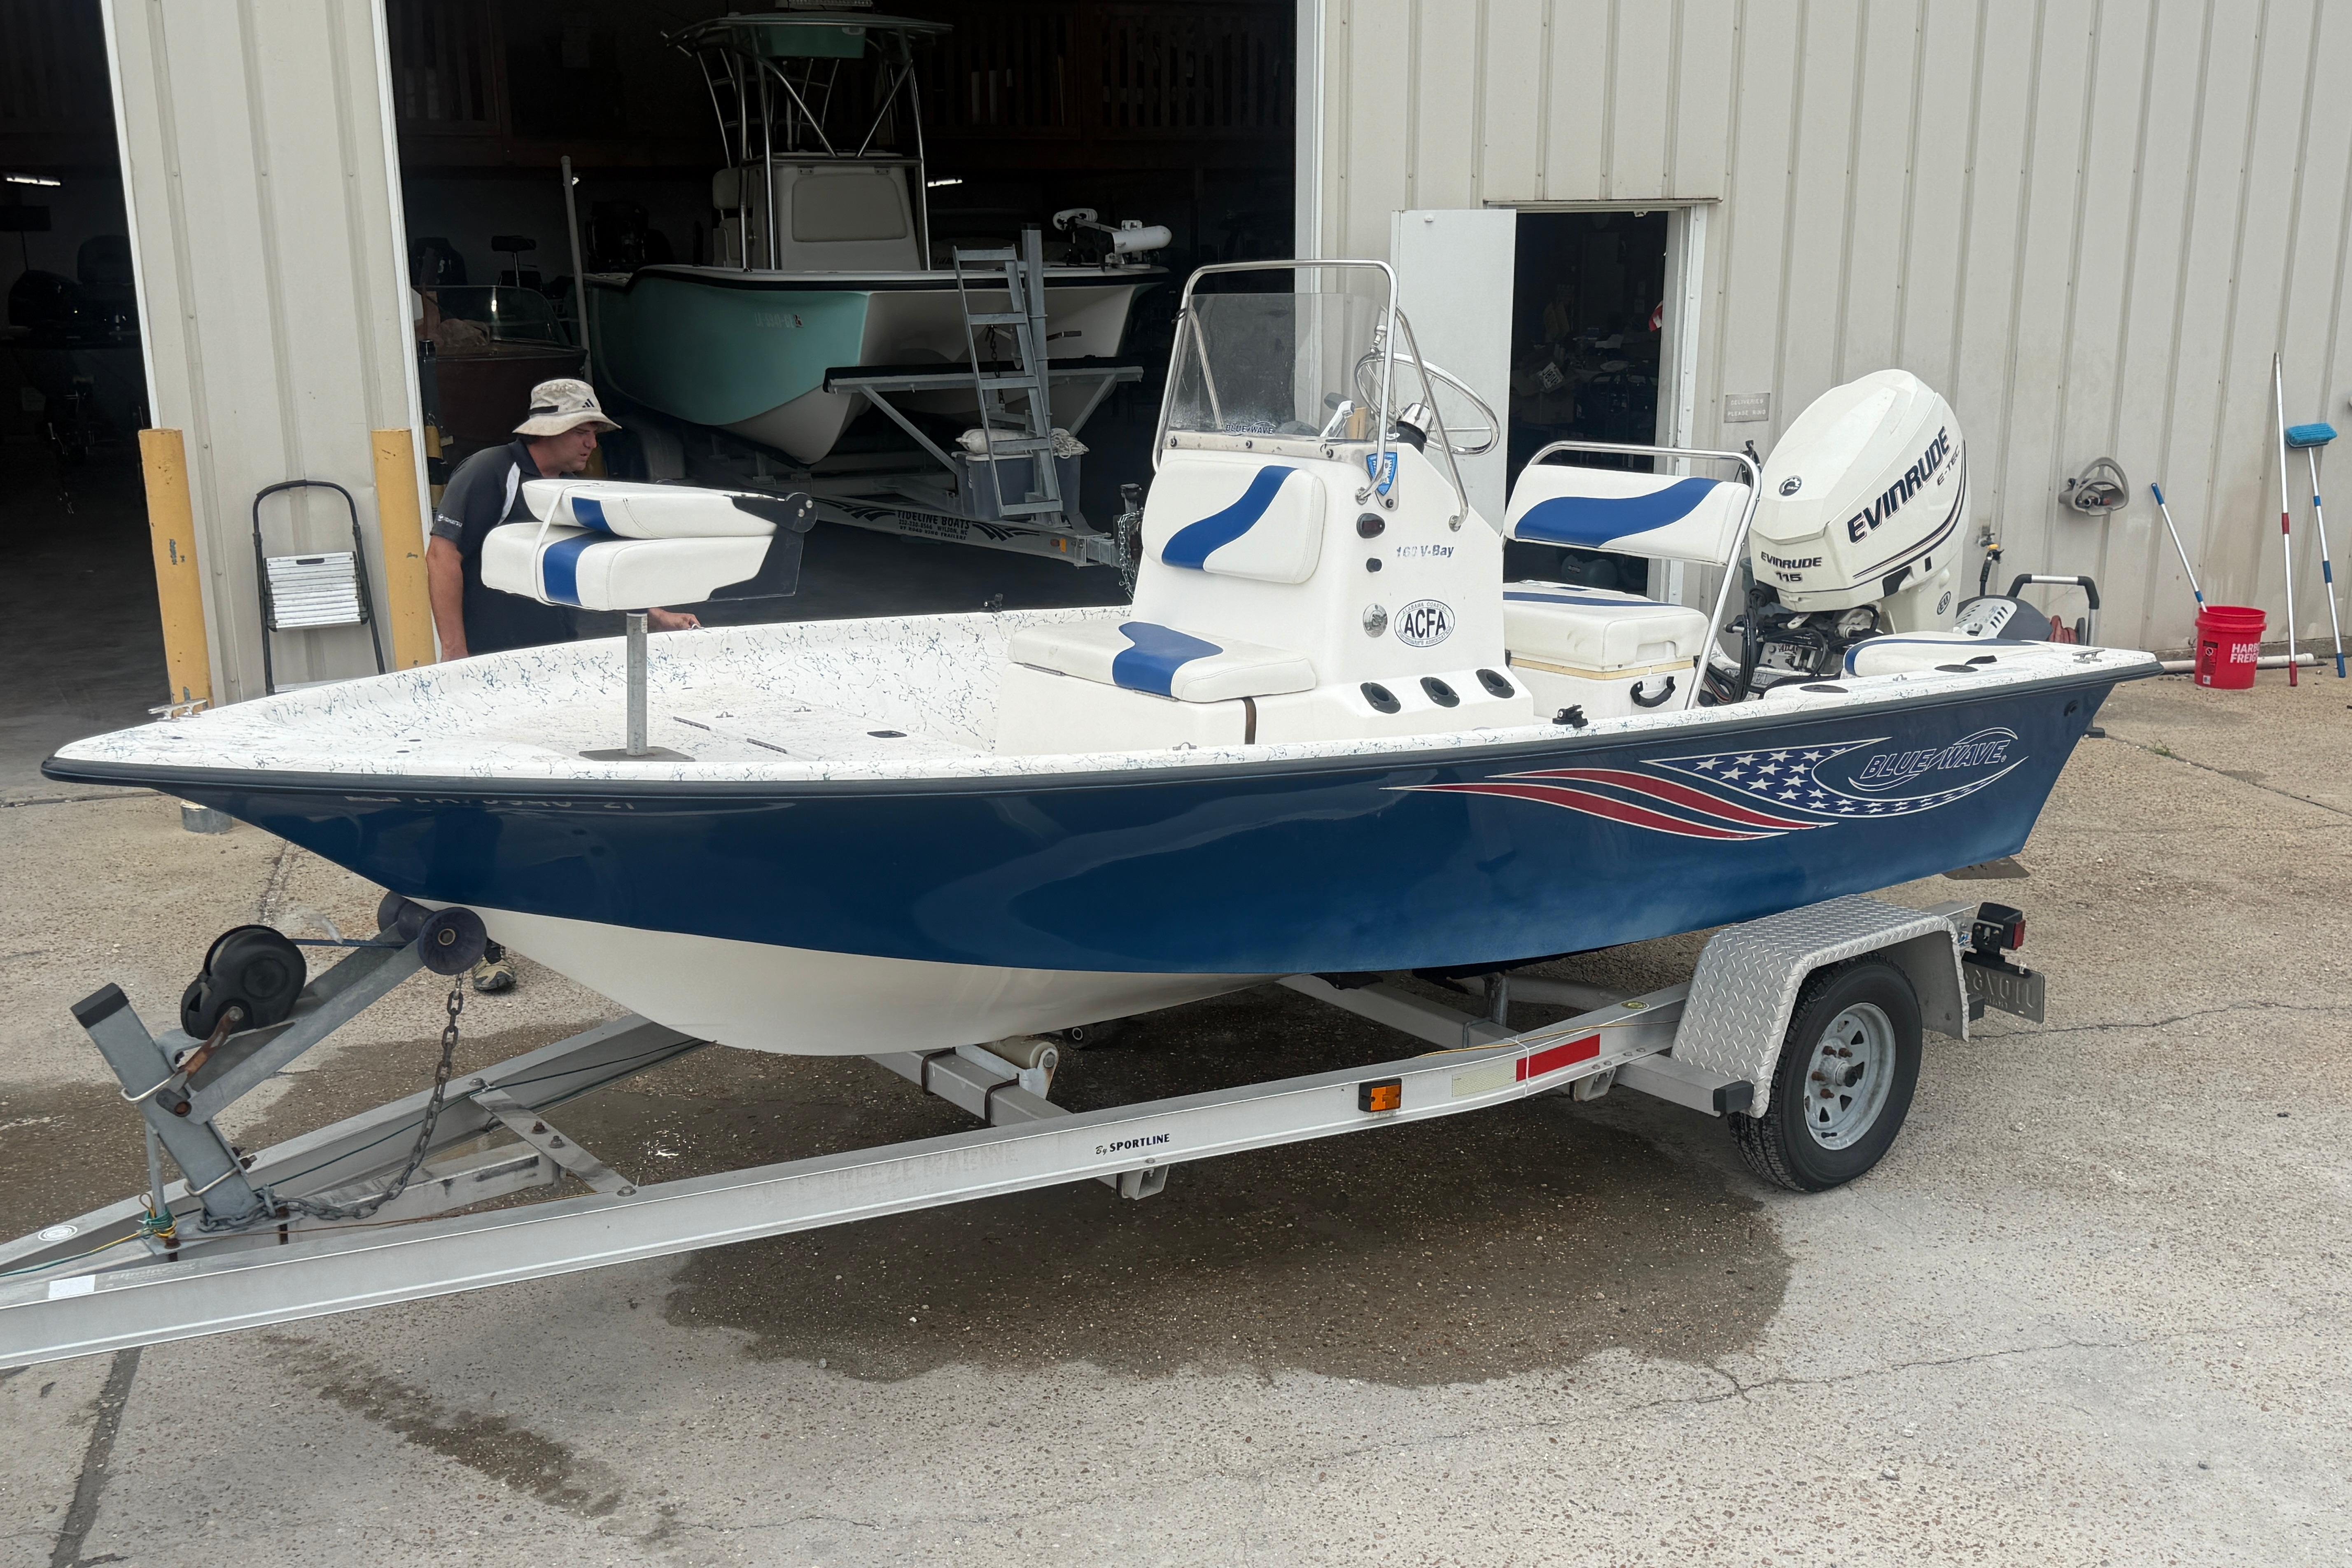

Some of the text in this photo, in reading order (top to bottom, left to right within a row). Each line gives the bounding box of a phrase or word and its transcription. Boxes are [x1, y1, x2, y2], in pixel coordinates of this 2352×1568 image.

[1226, 423, 1275, 434] BLUE WAVE
[1937, 445, 1960, 486] E-TEC
[1847, 425, 1951, 544] EVINRUDE
[897, 510, 971, 530] TIDELINE BOATS
[1421, 545, 1454, 558] V-Bay
[1761, 551, 1822, 569] EVINRUDE
[1776, 571, 1803, 583] 115
[1402, 602, 1425, 615] ALABAMA
[1404, 608, 1446, 638] ACFA
[1860, 739, 2011, 779] BLUE WAVE
[1095, 1133, 1170, 1155] By SPORTLINE
